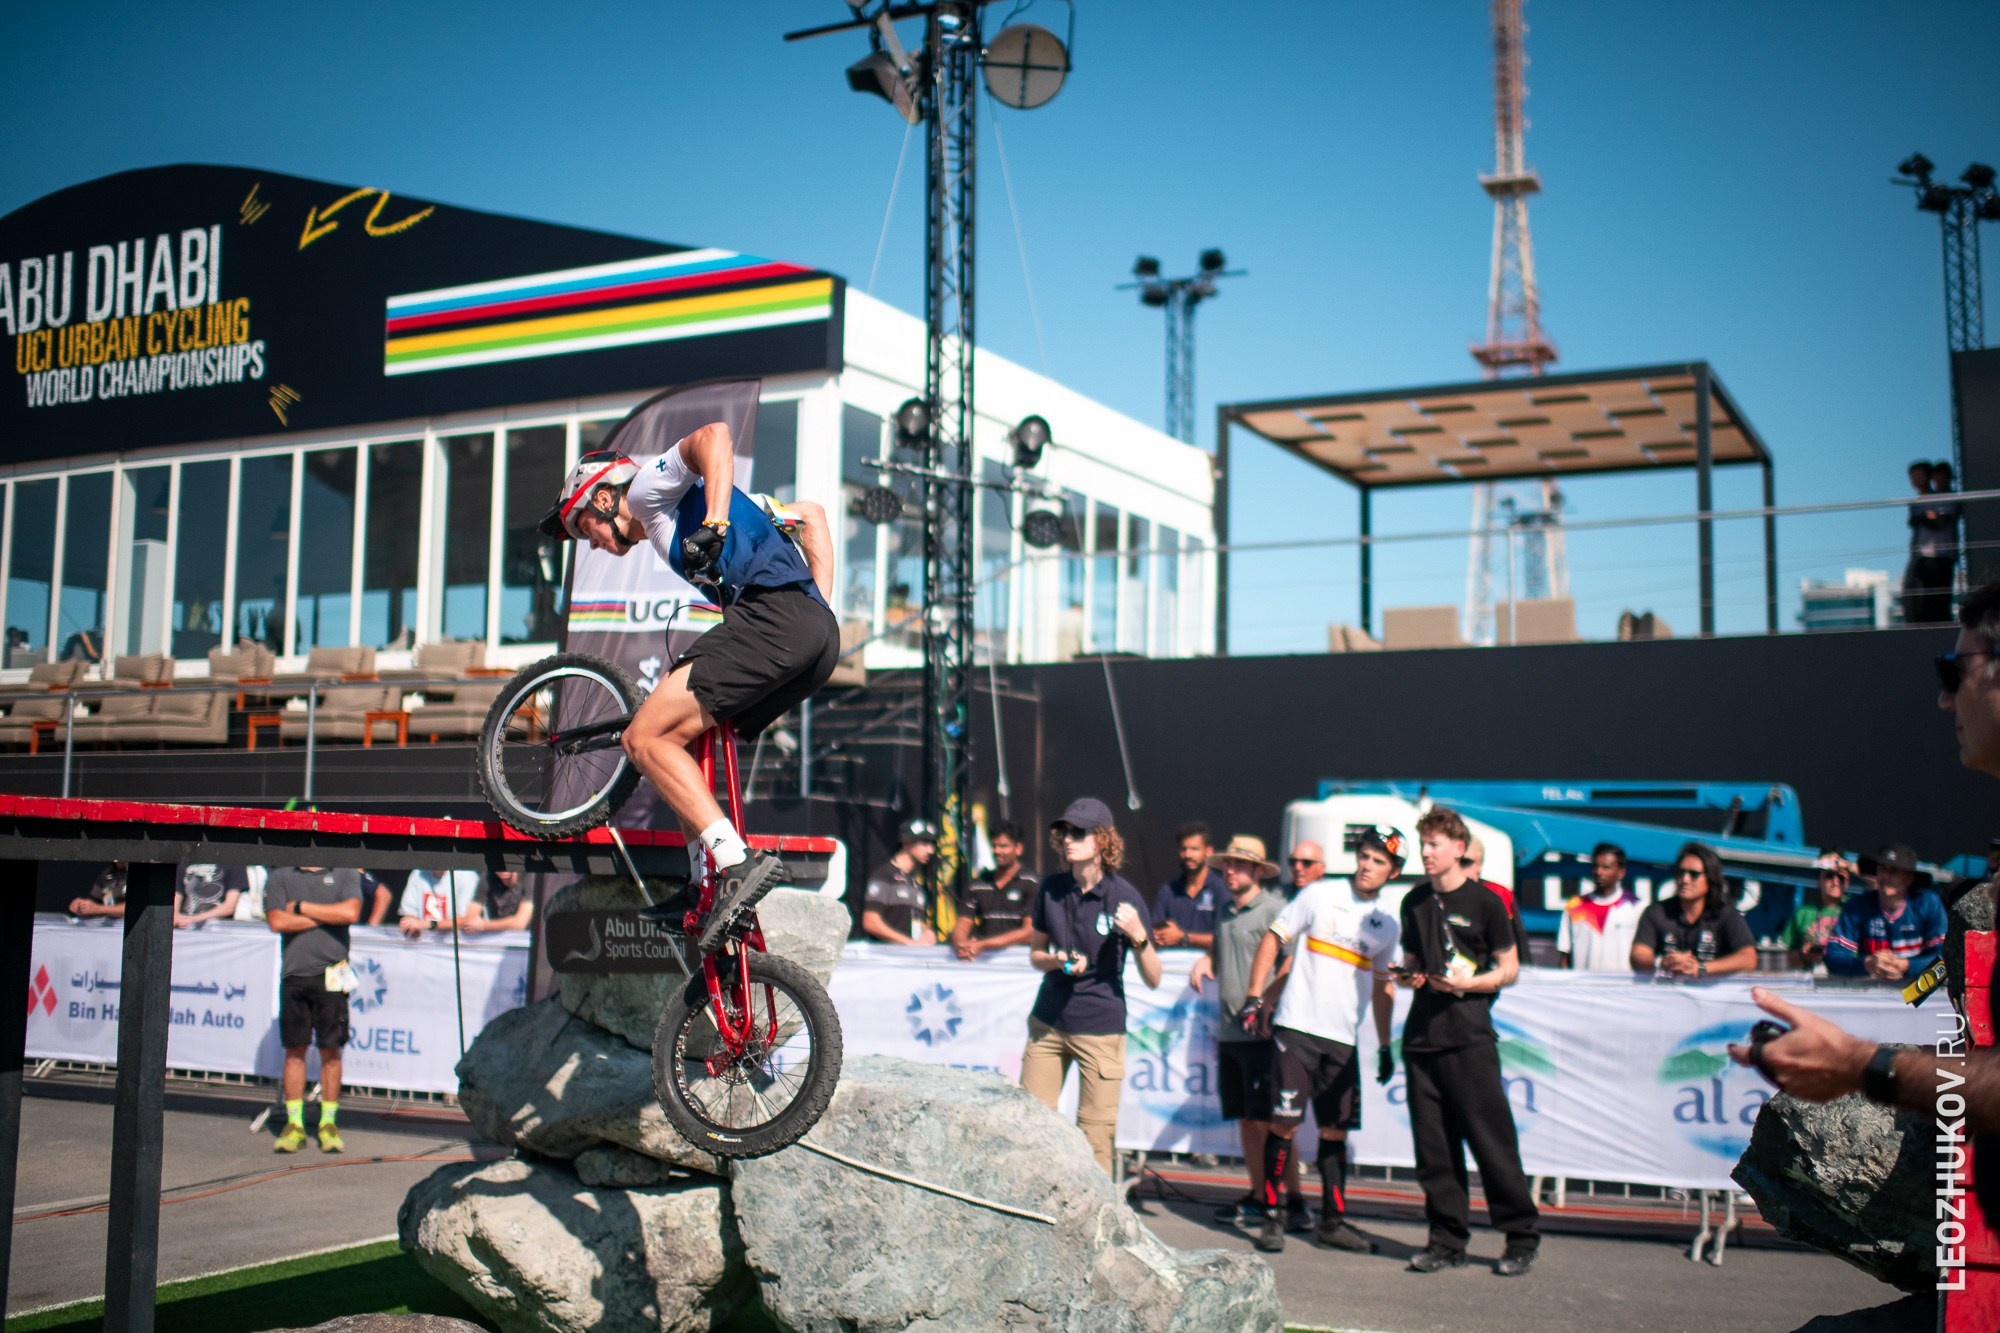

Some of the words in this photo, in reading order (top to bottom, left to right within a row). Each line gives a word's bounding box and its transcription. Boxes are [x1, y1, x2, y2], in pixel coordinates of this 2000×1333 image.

[0, 251, 73, 335] ABU
[86, 224, 222, 323] DHABI
[16, 329, 53, 374] UCI
[58, 316, 141, 368] URBAN
[146, 297, 249, 355] CYCLING
[26, 366, 95, 408] WORLD
[98, 340, 265, 399] CHAMPIONSHIPS
[629, 599, 680, 622] UCI
[605, 917, 635, 938] Abu
[605, 941, 642, 960] Sports
[644, 941, 686, 958] Counil
[68, 1001, 96, 1020] Bin
[202, 1009, 244, 1029] Auto
[348, 1026, 421, 1056] RJEEL
[1673, 1077, 1730, 1125] al
